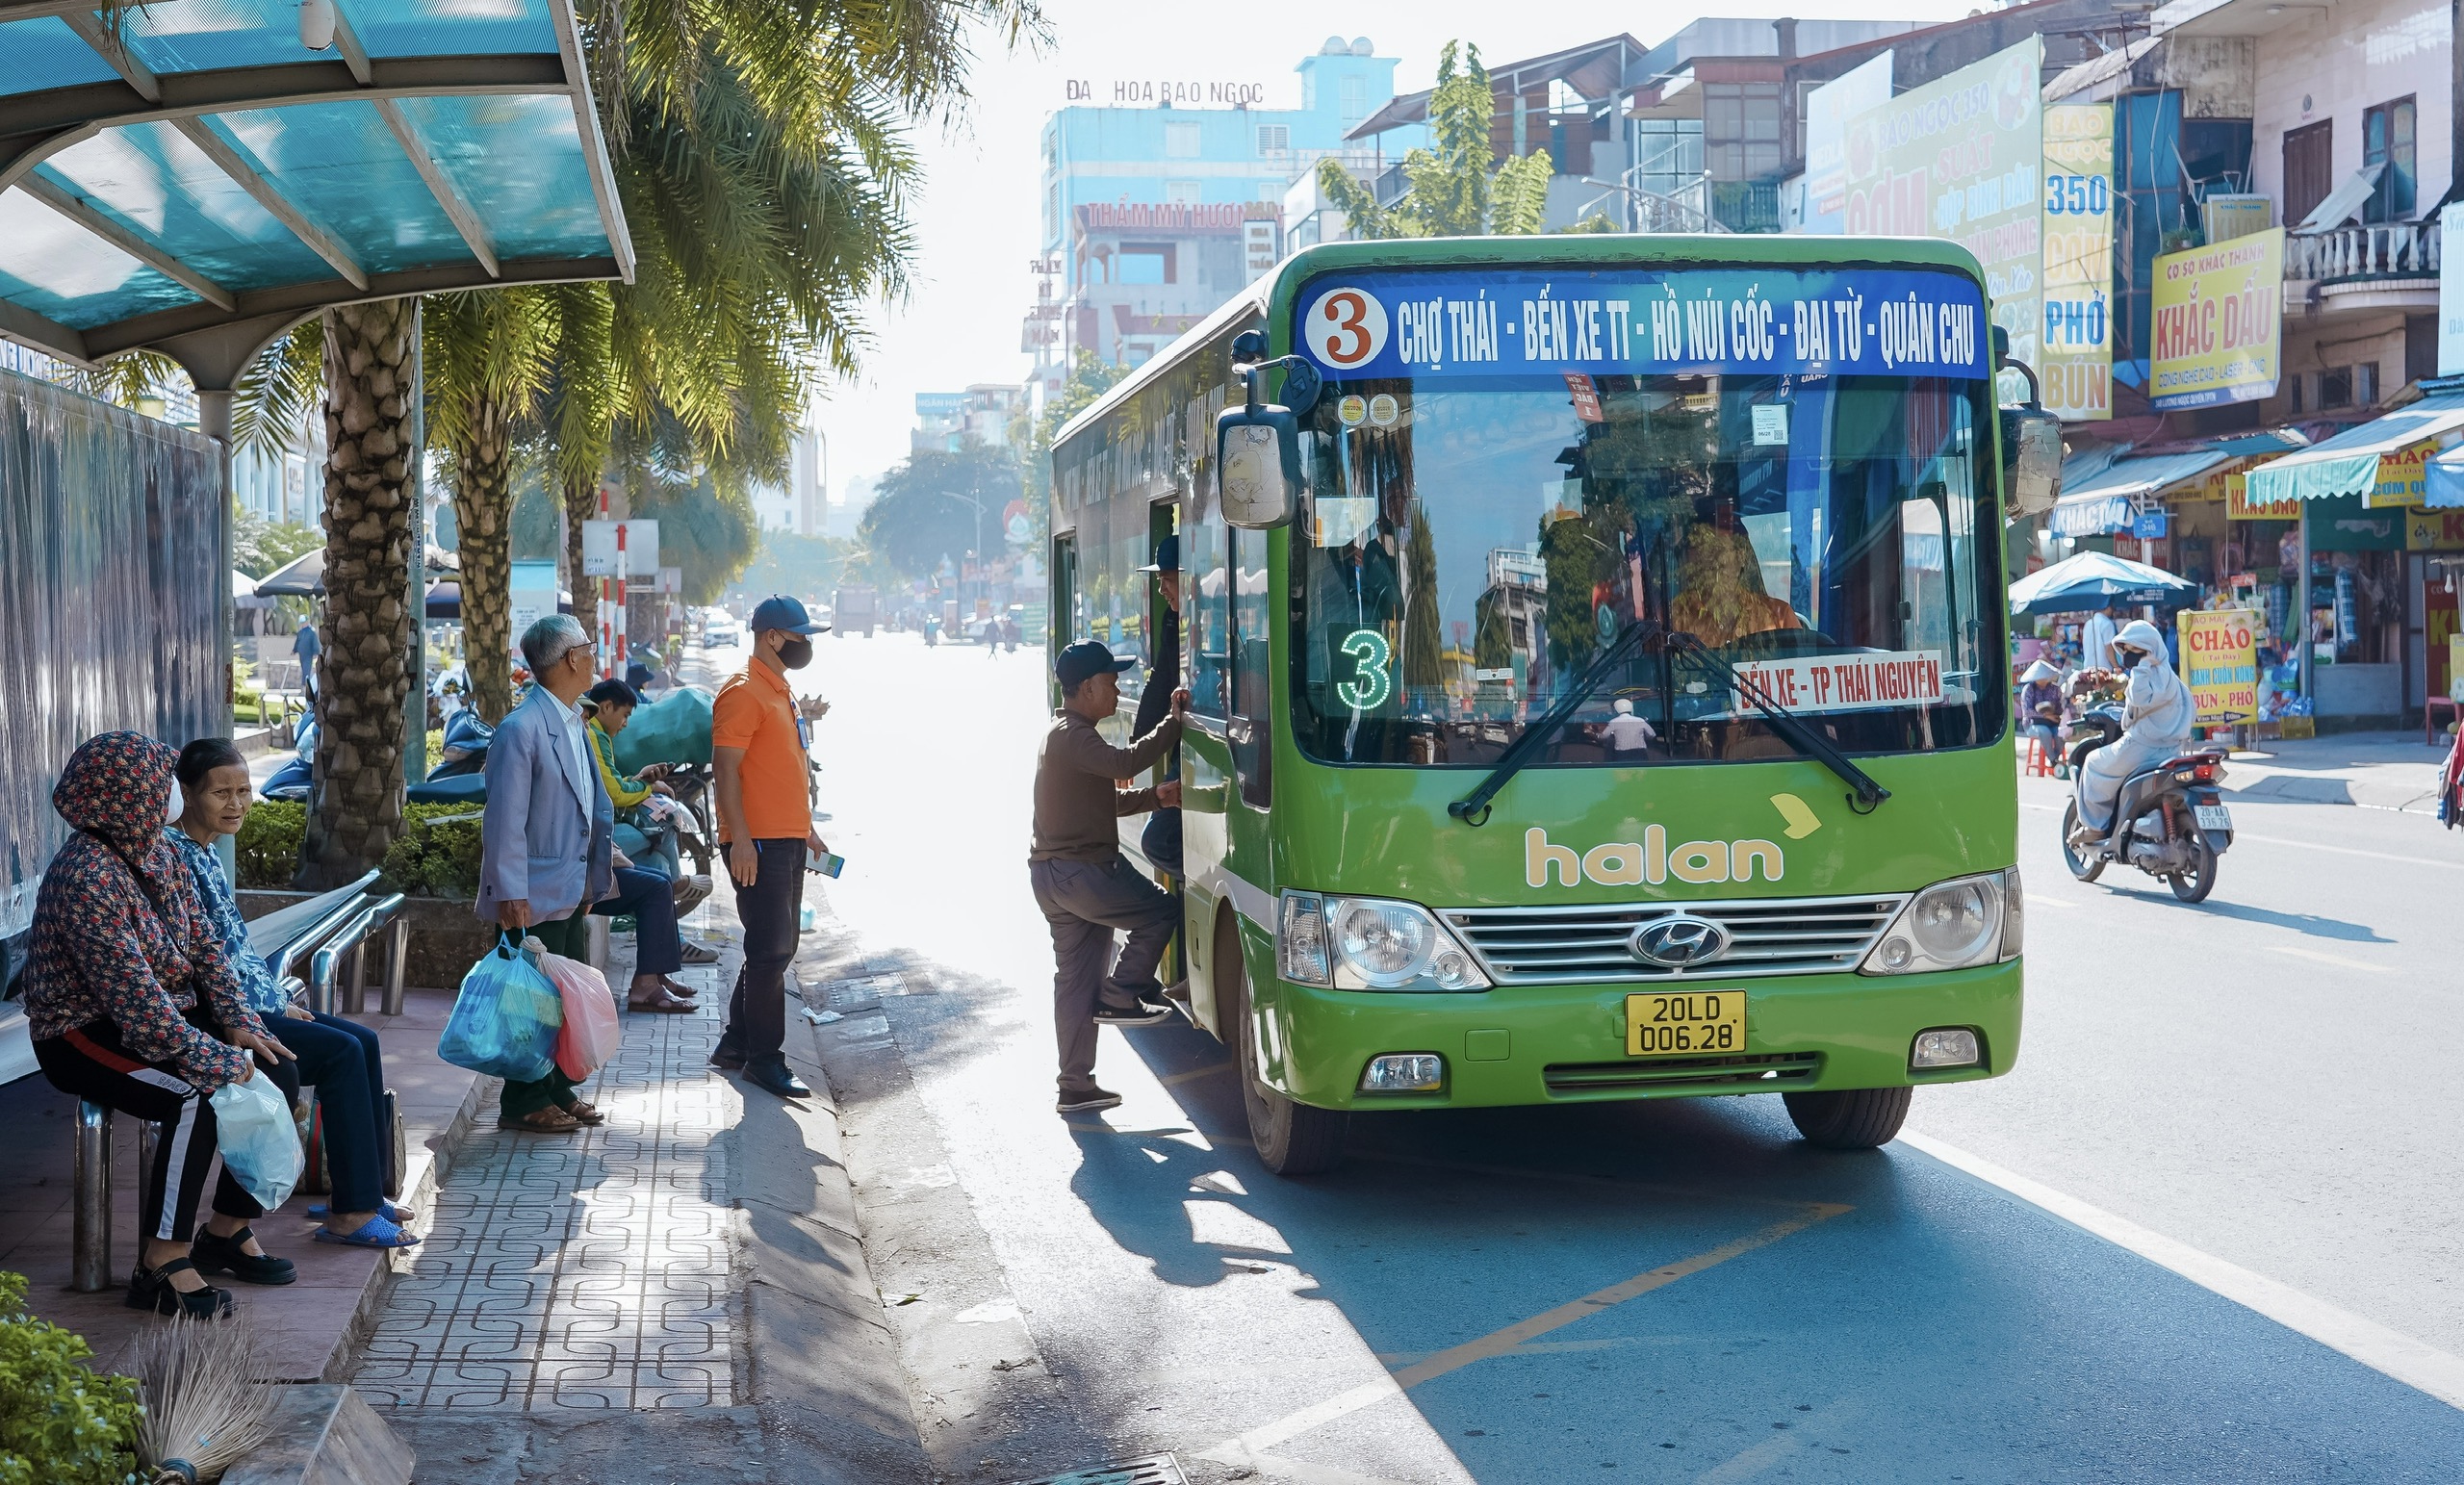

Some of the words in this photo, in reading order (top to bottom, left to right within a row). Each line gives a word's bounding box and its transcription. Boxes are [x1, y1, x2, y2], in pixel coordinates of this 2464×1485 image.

[1066, 80, 1091, 100] ĐA
[1962, 80, 1989, 121] 350
[2004, 163, 2036, 211] DÂN
[2046, 174, 2108, 216] 350
[2045, 228, 2110, 283] CƠM
[1323, 292, 1372, 364] 3
[1398, 295, 1444, 371] CHỢ
[1448, 289, 1499, 362] THÁI
[1524, 283, 1569, 361] BẾN
[1572, 299, 1603, 361] XE
[1606, 299, 1630, 361] TT
[1651, 282, 1682, 362] HỒ
[1686, 287, 1726, 362] NÚI
[1732, 282, 1774, 362] CỐC
[1794, 299, 1831, 368] ĐẠI
[1835, 286, 1862, 362] TỪ
[1881, 291, 1935, 370] QUÂN
[1938, 302, 1975, 366] CHU
[2046, 290, 2106, 346] PHỞ
[2156, 281, 2216, 362] KHẮC
[2222, 268, 2273, 349] DẤU
[2044, 355, 2108, 411] BÚN
[2190, 624, 2250, 652] CHÁO
[1337, 628, 1391, 710] 3
[1739, 661, 1773, 709] BẾN
[1775, 668, 1798, 706] XE
[1810, 666, 1831, 704] TP
[1835, 657, 1872, 704] THÁI
[1875, 653, 1940, 701] NGUYÊN
[2229, 684, 2254, 706] PHỞ
[1525, 824, 1784, 887] halan
[1653, 995, 1721, 1022] 20LD
[1640, 1024, 1732, 1052] 006.28
